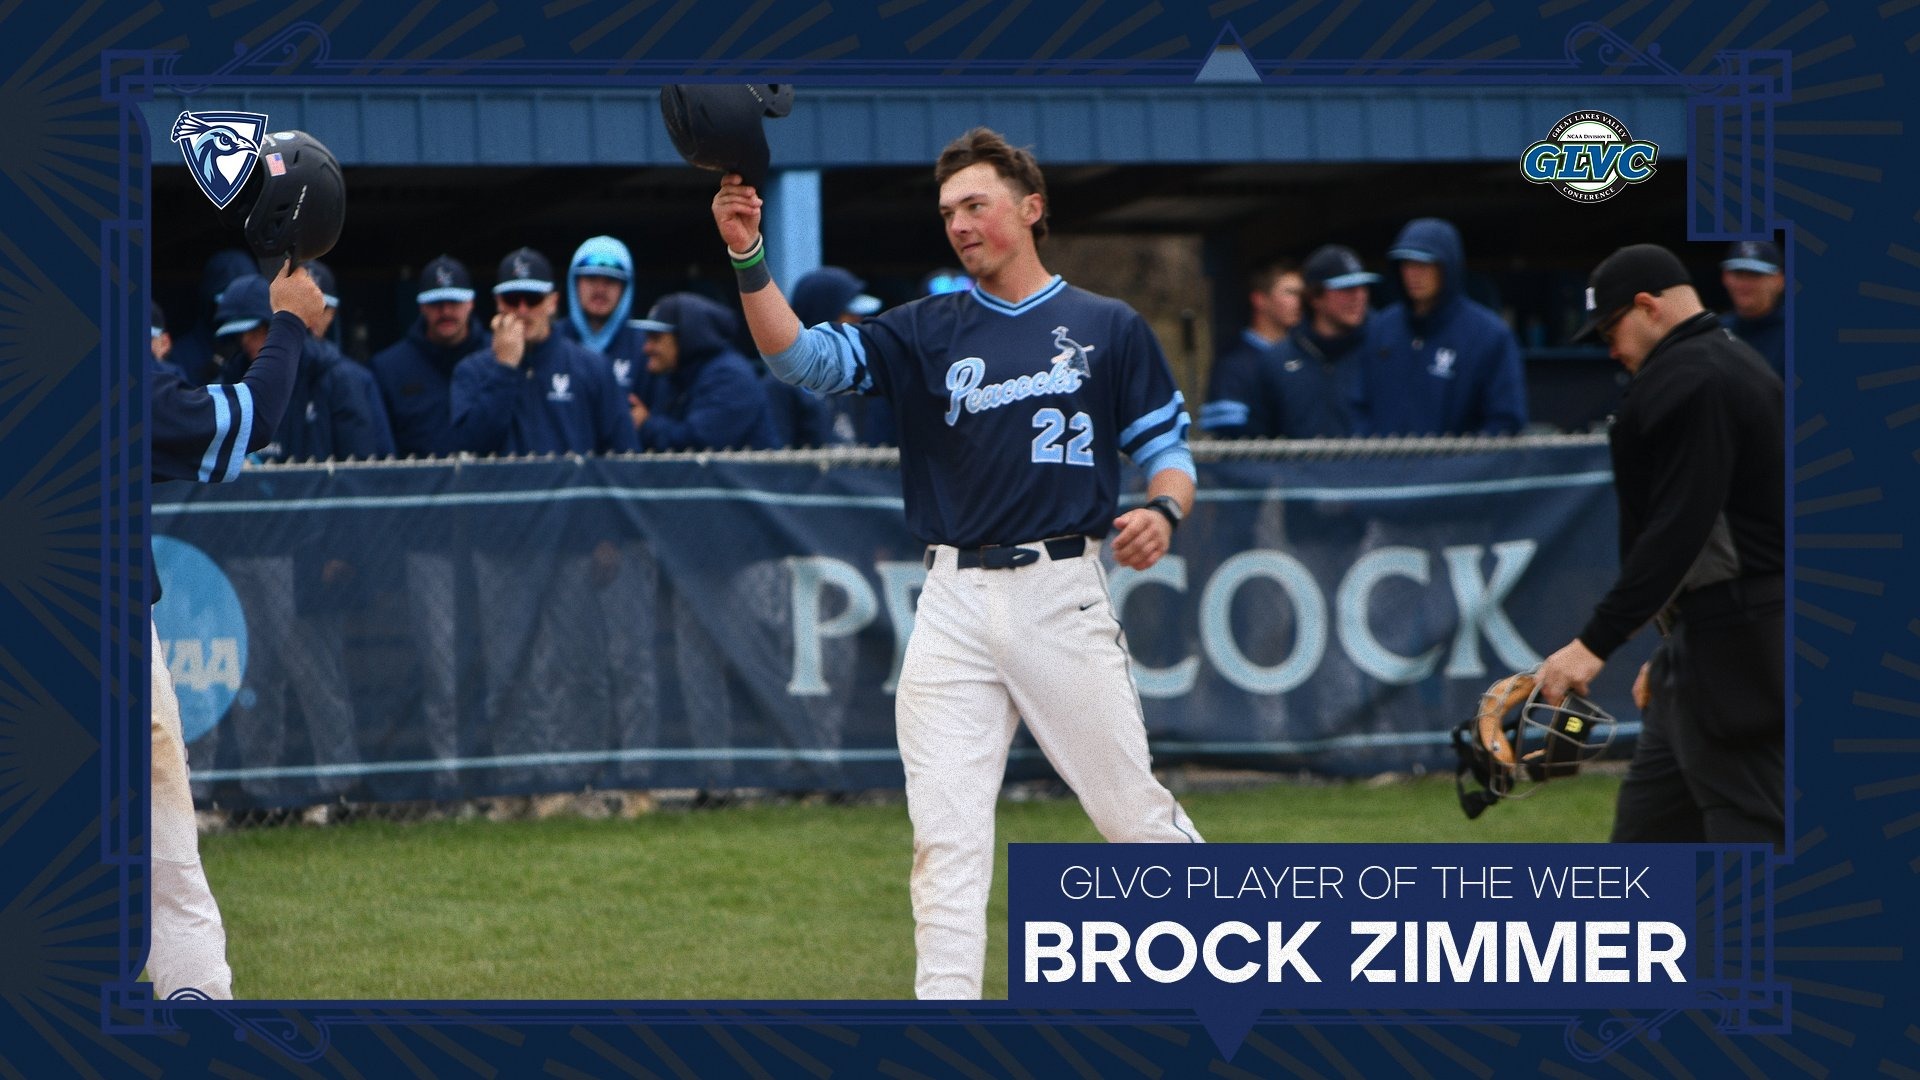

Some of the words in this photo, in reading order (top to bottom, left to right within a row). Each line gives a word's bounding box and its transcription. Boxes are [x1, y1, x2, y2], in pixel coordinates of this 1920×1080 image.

[944, 356, 1083, 427] Peacocks
[1031, 407, 1095, 466] 22
[785, 539, 1544, 697] PECOCK
